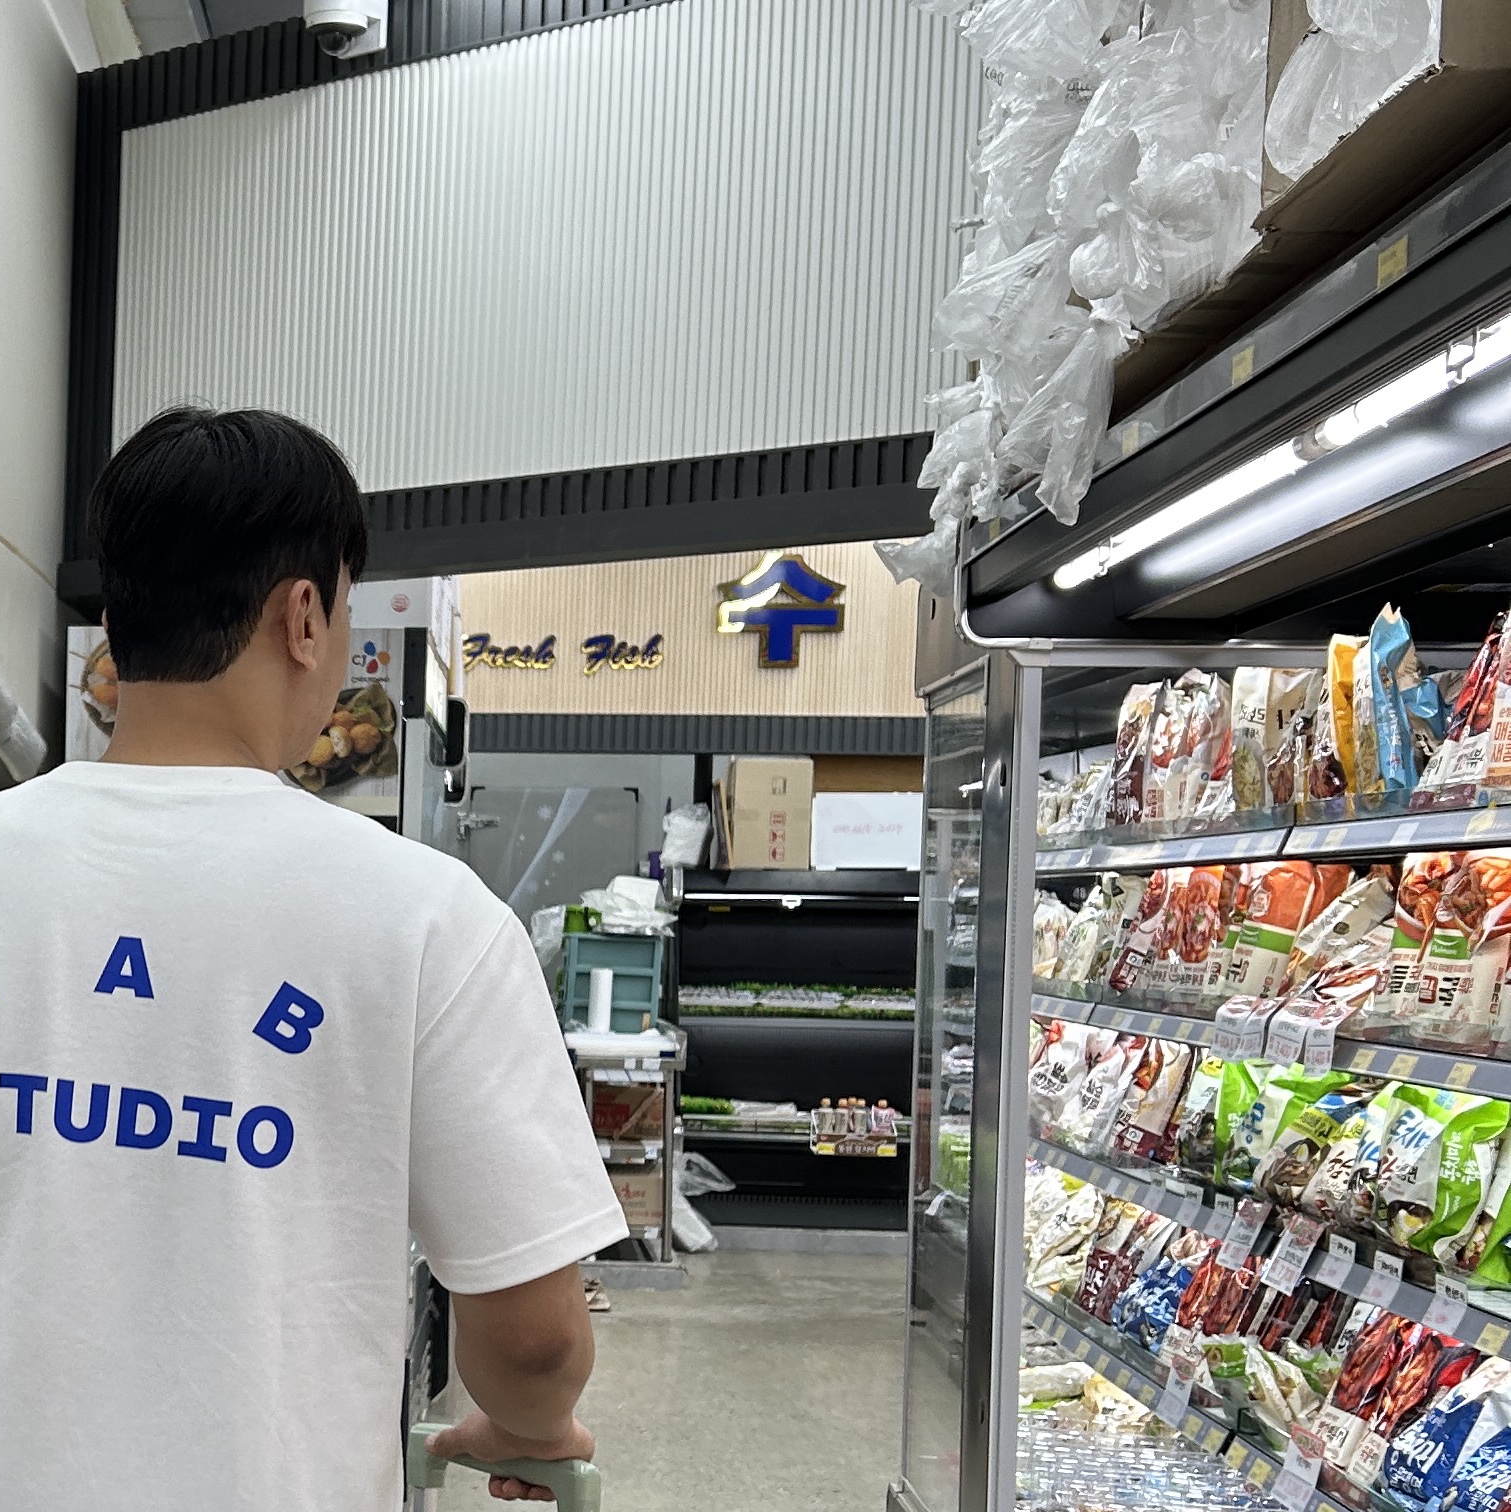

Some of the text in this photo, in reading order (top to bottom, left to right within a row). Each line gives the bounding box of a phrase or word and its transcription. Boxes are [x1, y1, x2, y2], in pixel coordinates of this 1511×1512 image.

[716, 552, 846, 669] 수
[462, 633, 664, 676] Fresh Fish
